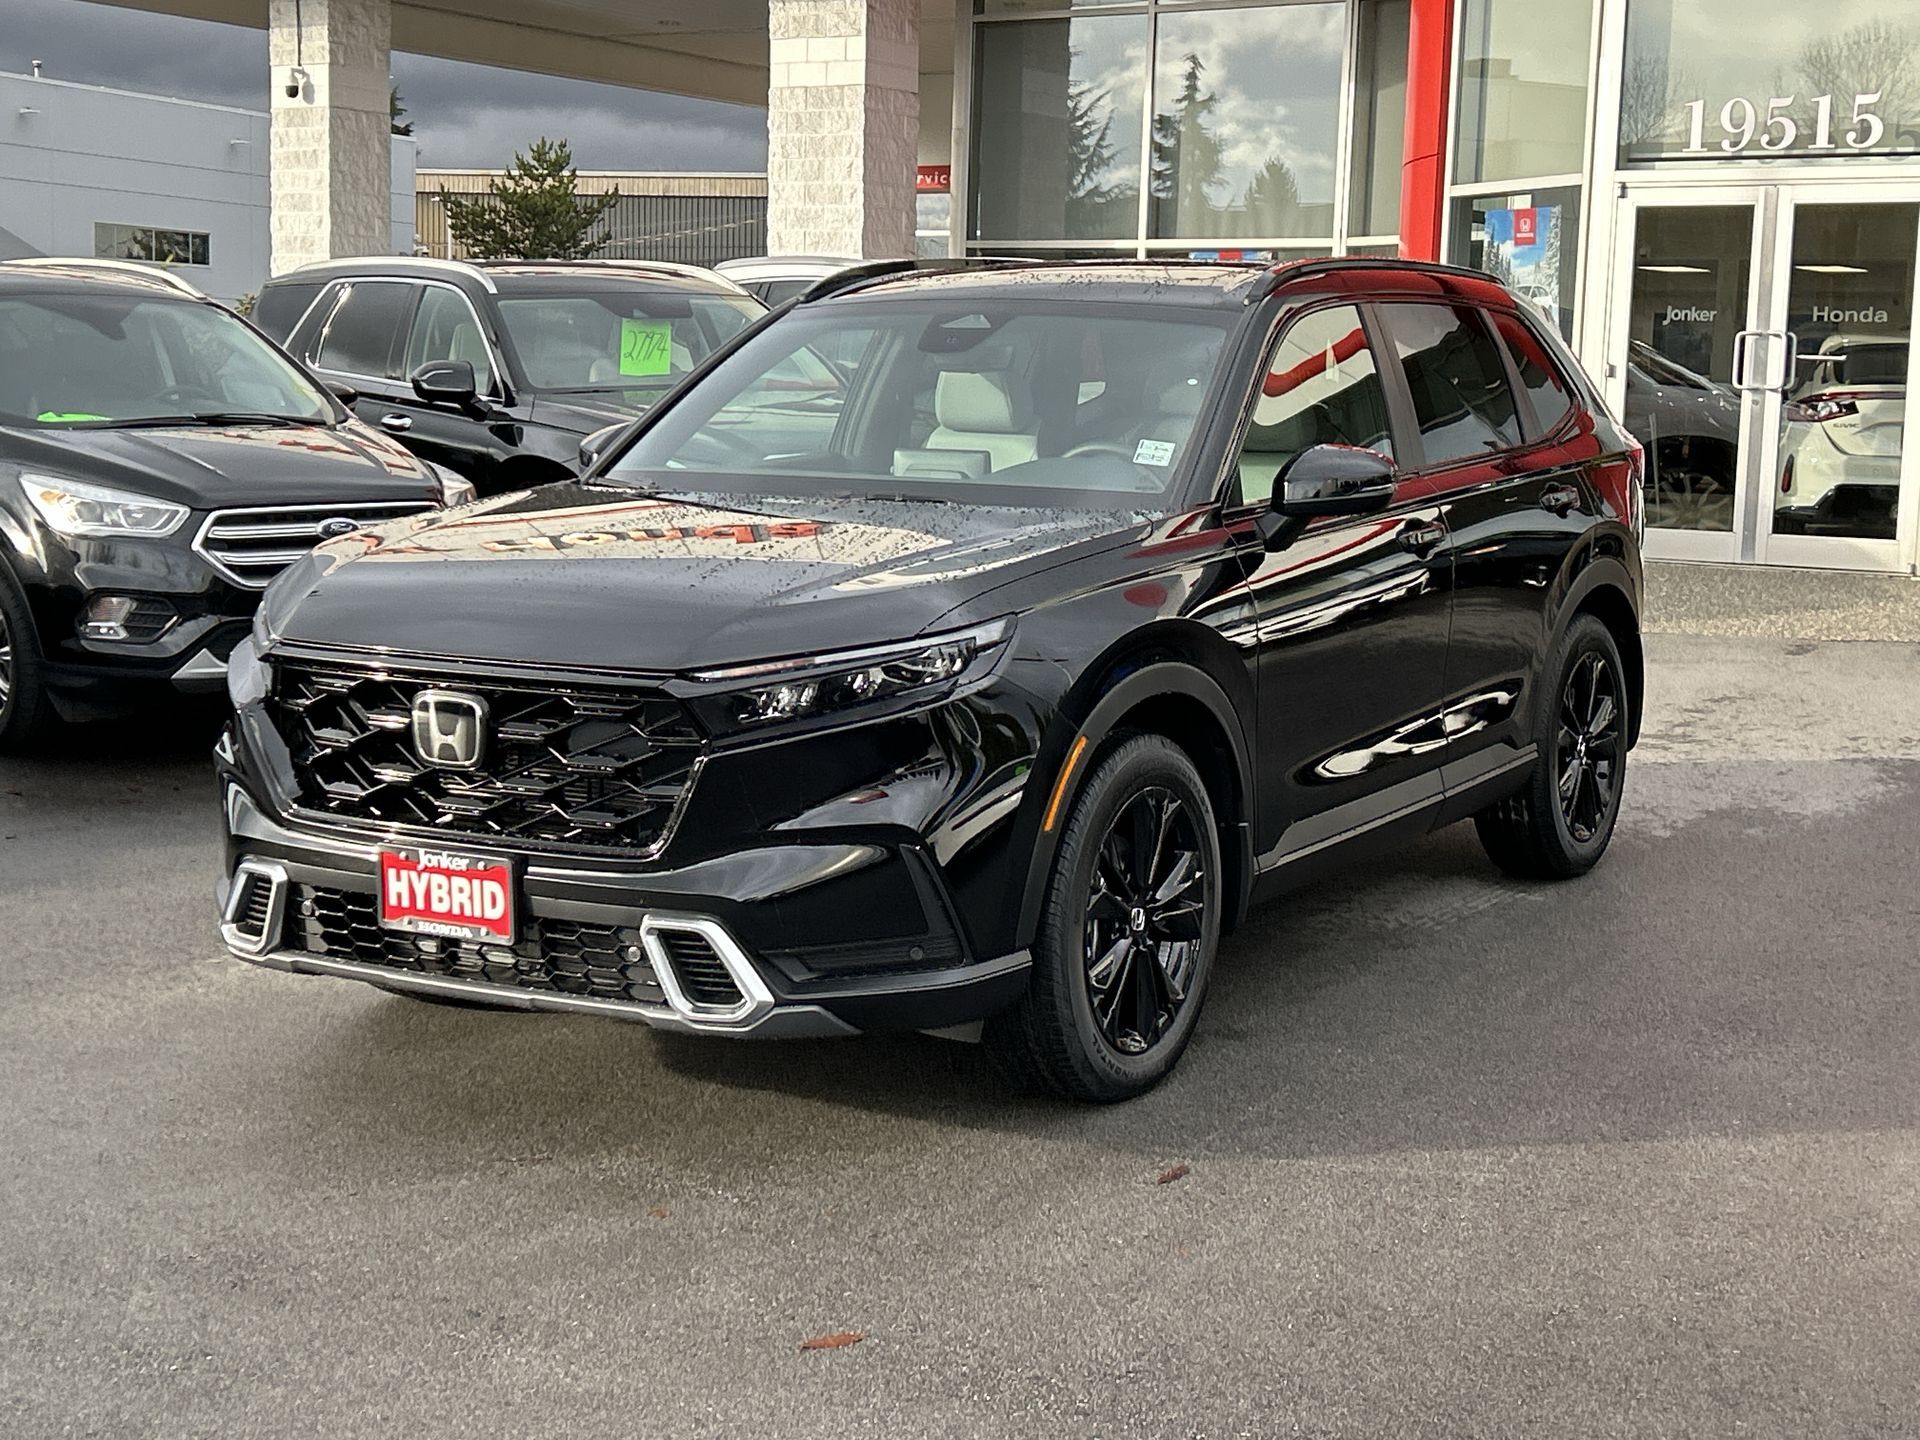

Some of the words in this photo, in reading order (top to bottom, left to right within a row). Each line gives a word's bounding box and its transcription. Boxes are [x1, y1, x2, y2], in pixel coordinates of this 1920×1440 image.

[1682, 90, 1884, 153] 19515
[916, 171, 948, 185] rvic
[1662, 305, 1718, 326] Jonker
[1812, 306, 1888, 323] Honda
[416, 849, 470, 872] Jonker
[387, 867, 506, 921] HYBRID
[417, 921, 473, 938] HONDA
